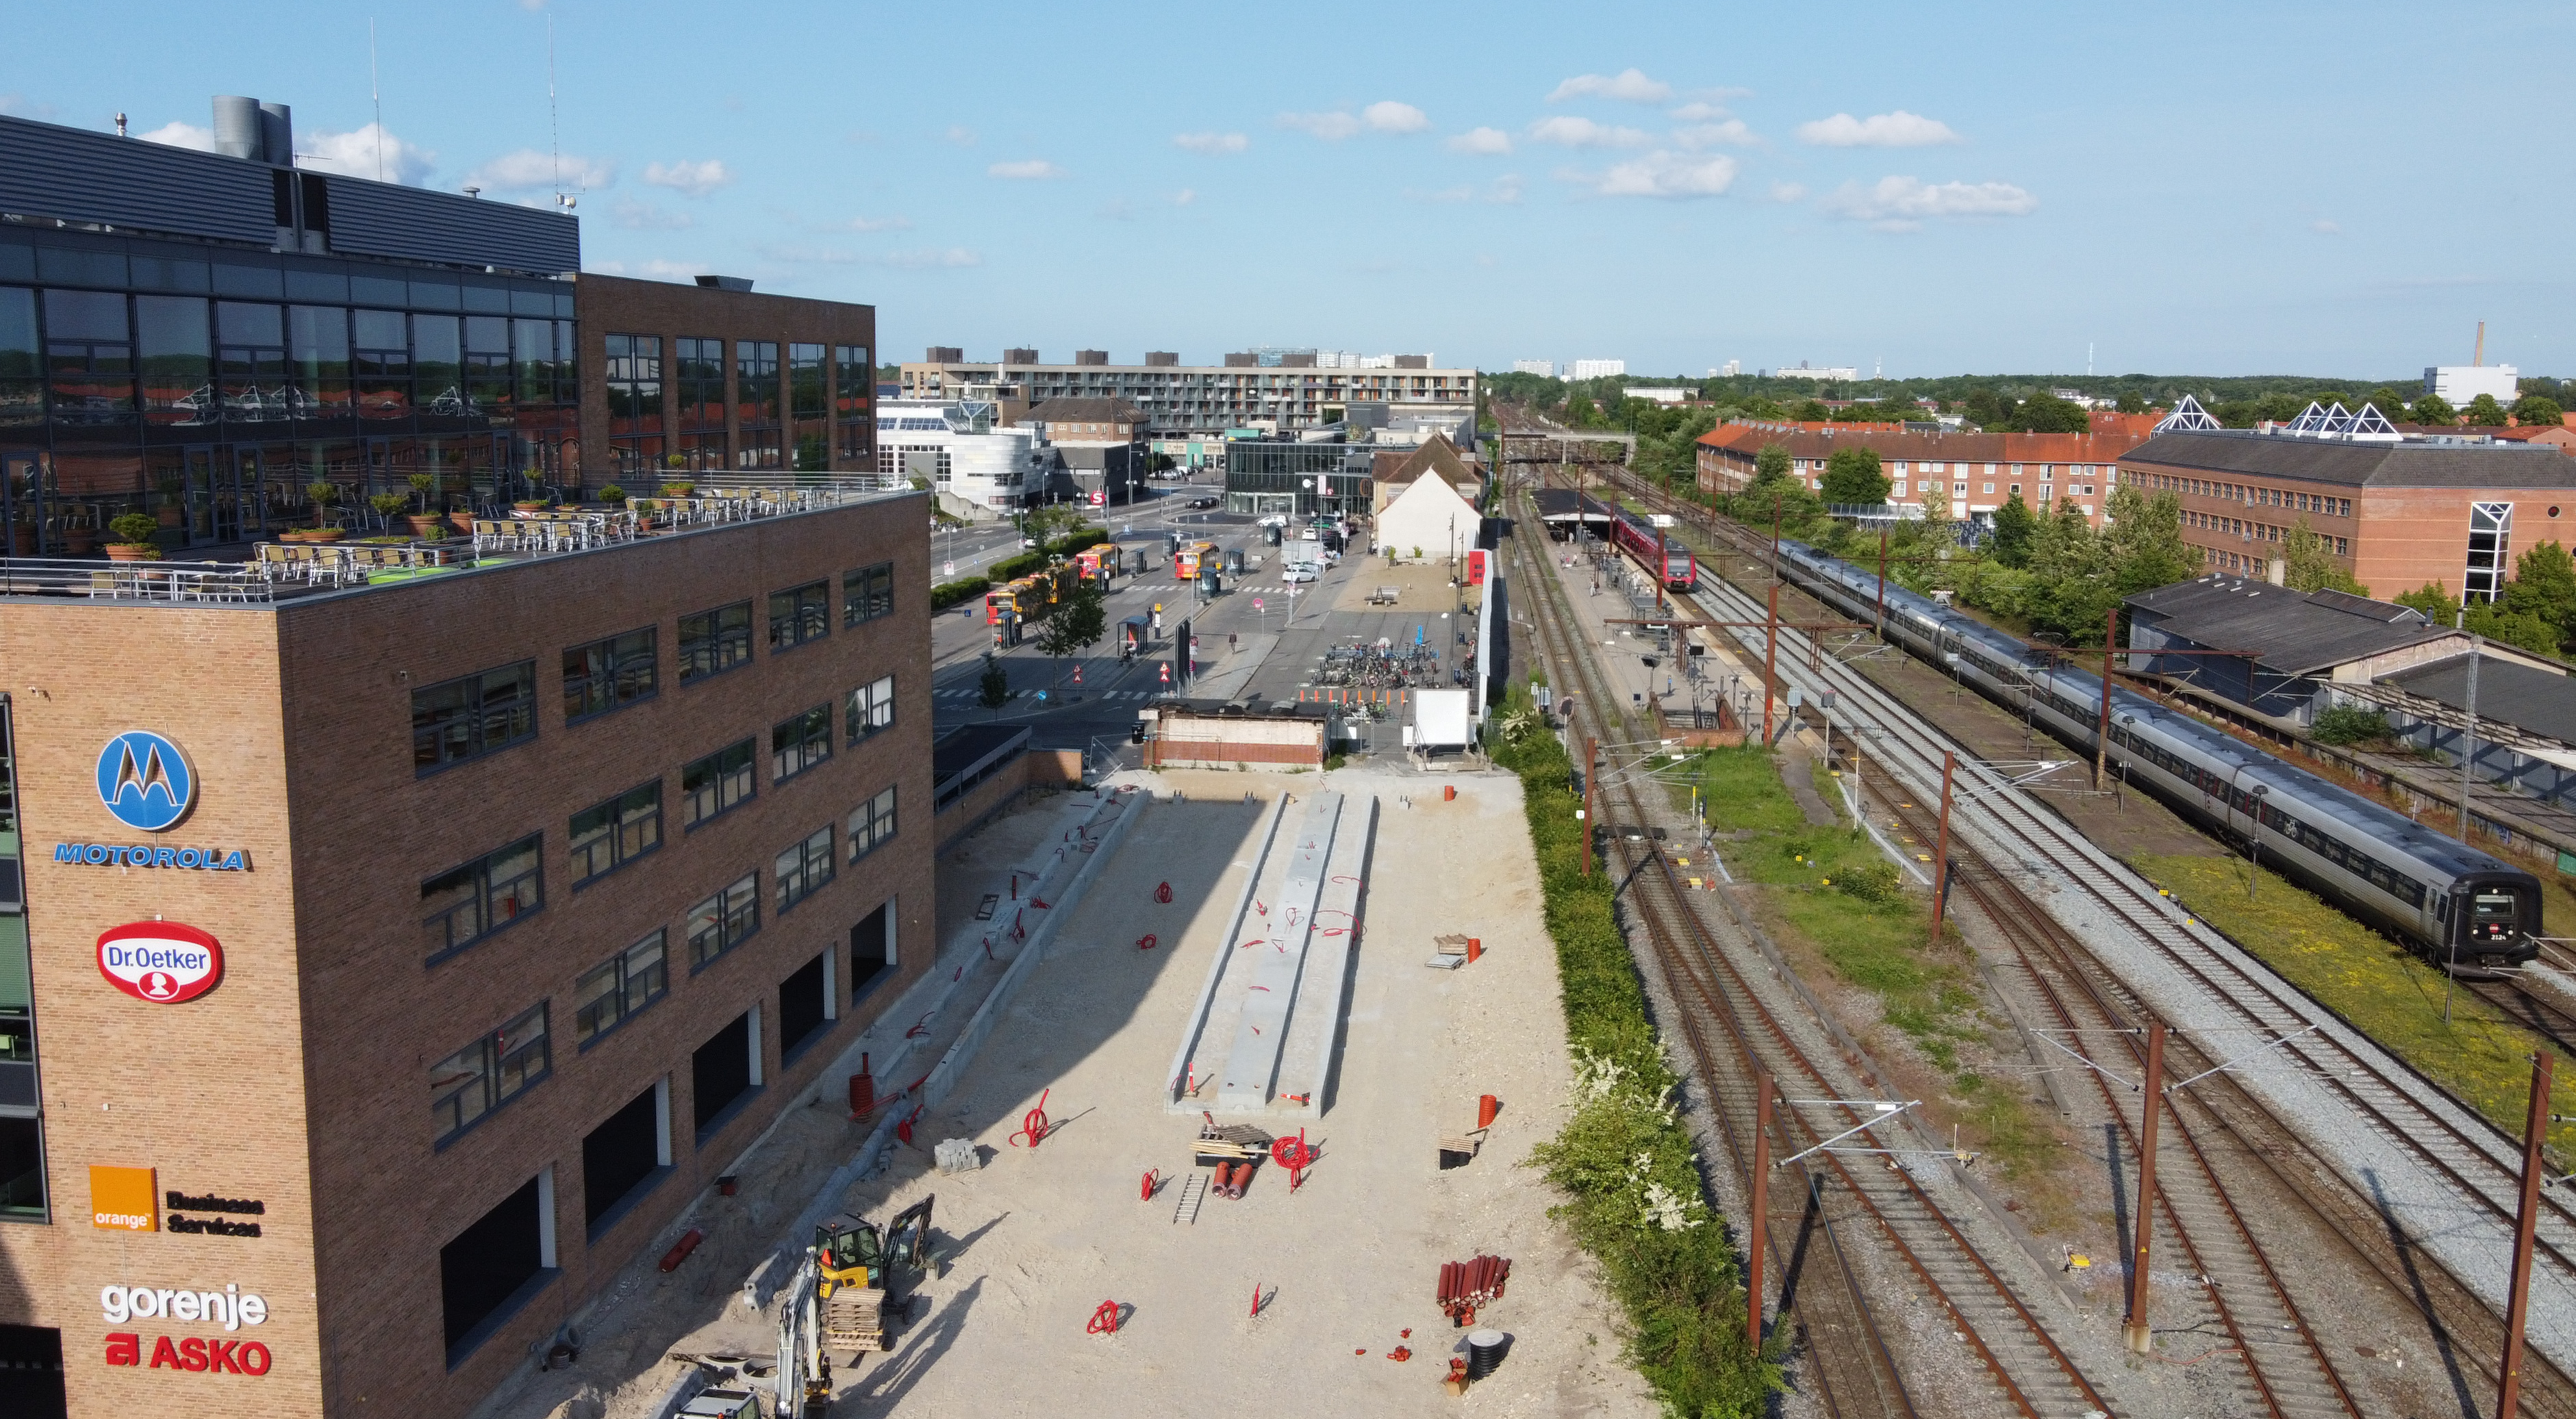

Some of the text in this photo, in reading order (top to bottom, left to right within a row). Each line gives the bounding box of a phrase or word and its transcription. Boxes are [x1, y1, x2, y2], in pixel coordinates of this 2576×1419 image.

[1093, 493, 1102, 503] S
[54, 843, 245, 869] MOTOROLA
[166, 1191, 265, 1214] Business
[95, 1213, 147, 1229] orange
[167, 1214, 262, 1238] Services
[101, 1283, 267, 1331] gorenje
[150, 1335, 270, 1376] ASKO
